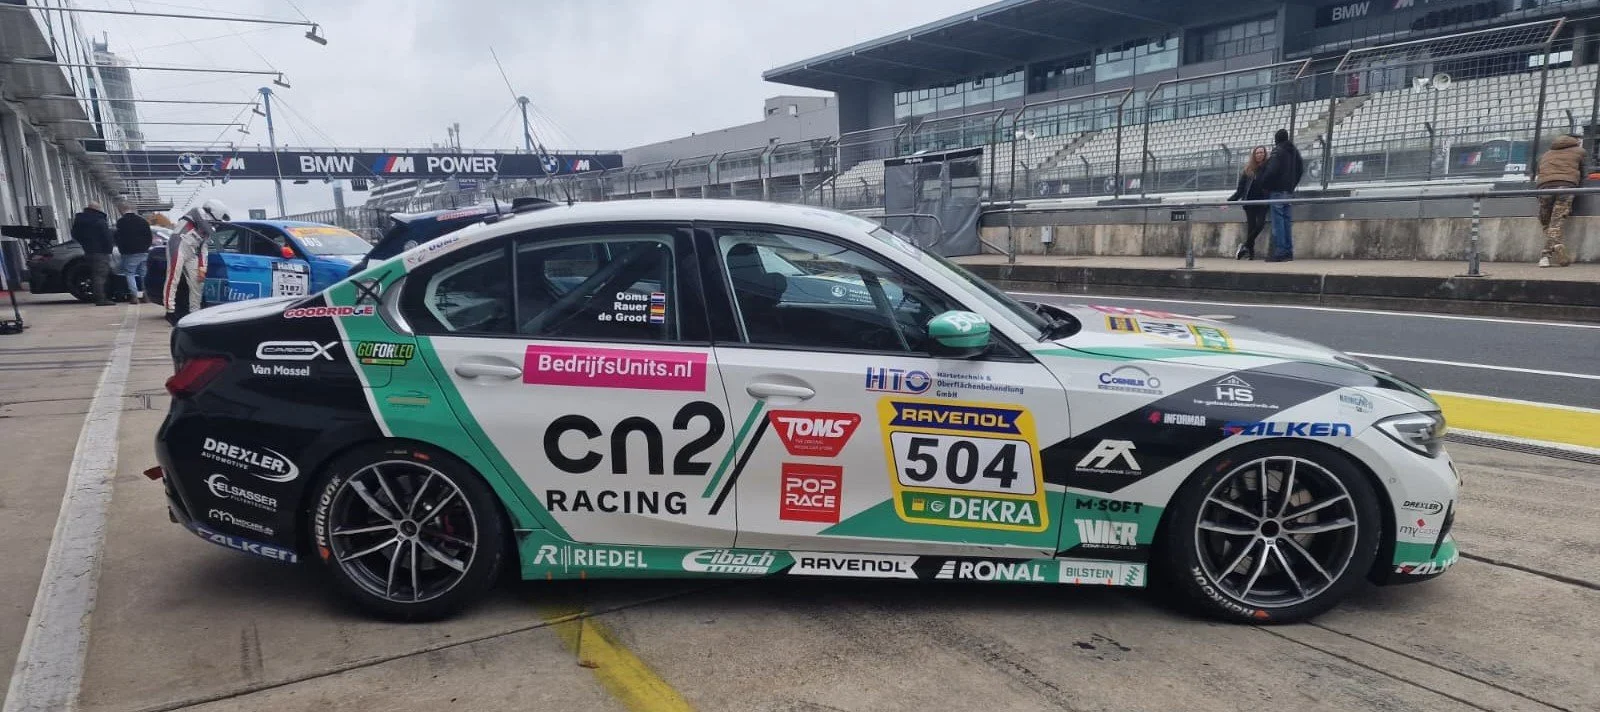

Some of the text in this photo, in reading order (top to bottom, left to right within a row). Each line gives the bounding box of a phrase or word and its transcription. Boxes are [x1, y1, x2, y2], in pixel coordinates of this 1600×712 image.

[1332, 3, 1369, 21] BMW
[300, 156, 354, 172] BMW
[427, 156, 498, 173] POWER
[616, 292, 648, 301] Ooms
[284, 304, 375, 318] GOODRIDGE
[614, 302, 647, 311] Rauer
[598, 312, 647, 322] de Groot
[357, 342, 414, 359] GOFORLED
[251, 364, 310, 376] Van Mossel
[538, 354, 692, 378] BedrijfsUnits.nl
[866, 367, 932, 394] HTO
[1216, 386, 1254, 401] HS
[902, 408, 1010, 428] RAVENOL
[1163, 413, 1206, 427] INFORMAR
[777, 417, 852, 442] TOMS
[1222, 421, 1353, 437] FALKEN
[543, 401, 725, 475] cn2
[203, 437, 286, 473] DREXLER
[905, 437, 1018, 488] 504
[787, 478, 837, 493] POP
[546, 490, 687, 514] RACING
[785, 493, 836, 508] RACE
[949, 497, 1034, 525] DEKRA
[574, 549, 648, 568] RIEDEL
[682, 549, 775, 573] Eibach
[800, 557, 907, 573] RAVENOL
[959, 560, 1045, 581] RONAL
[1066, 567, 1113, 578] BILSTEIN
